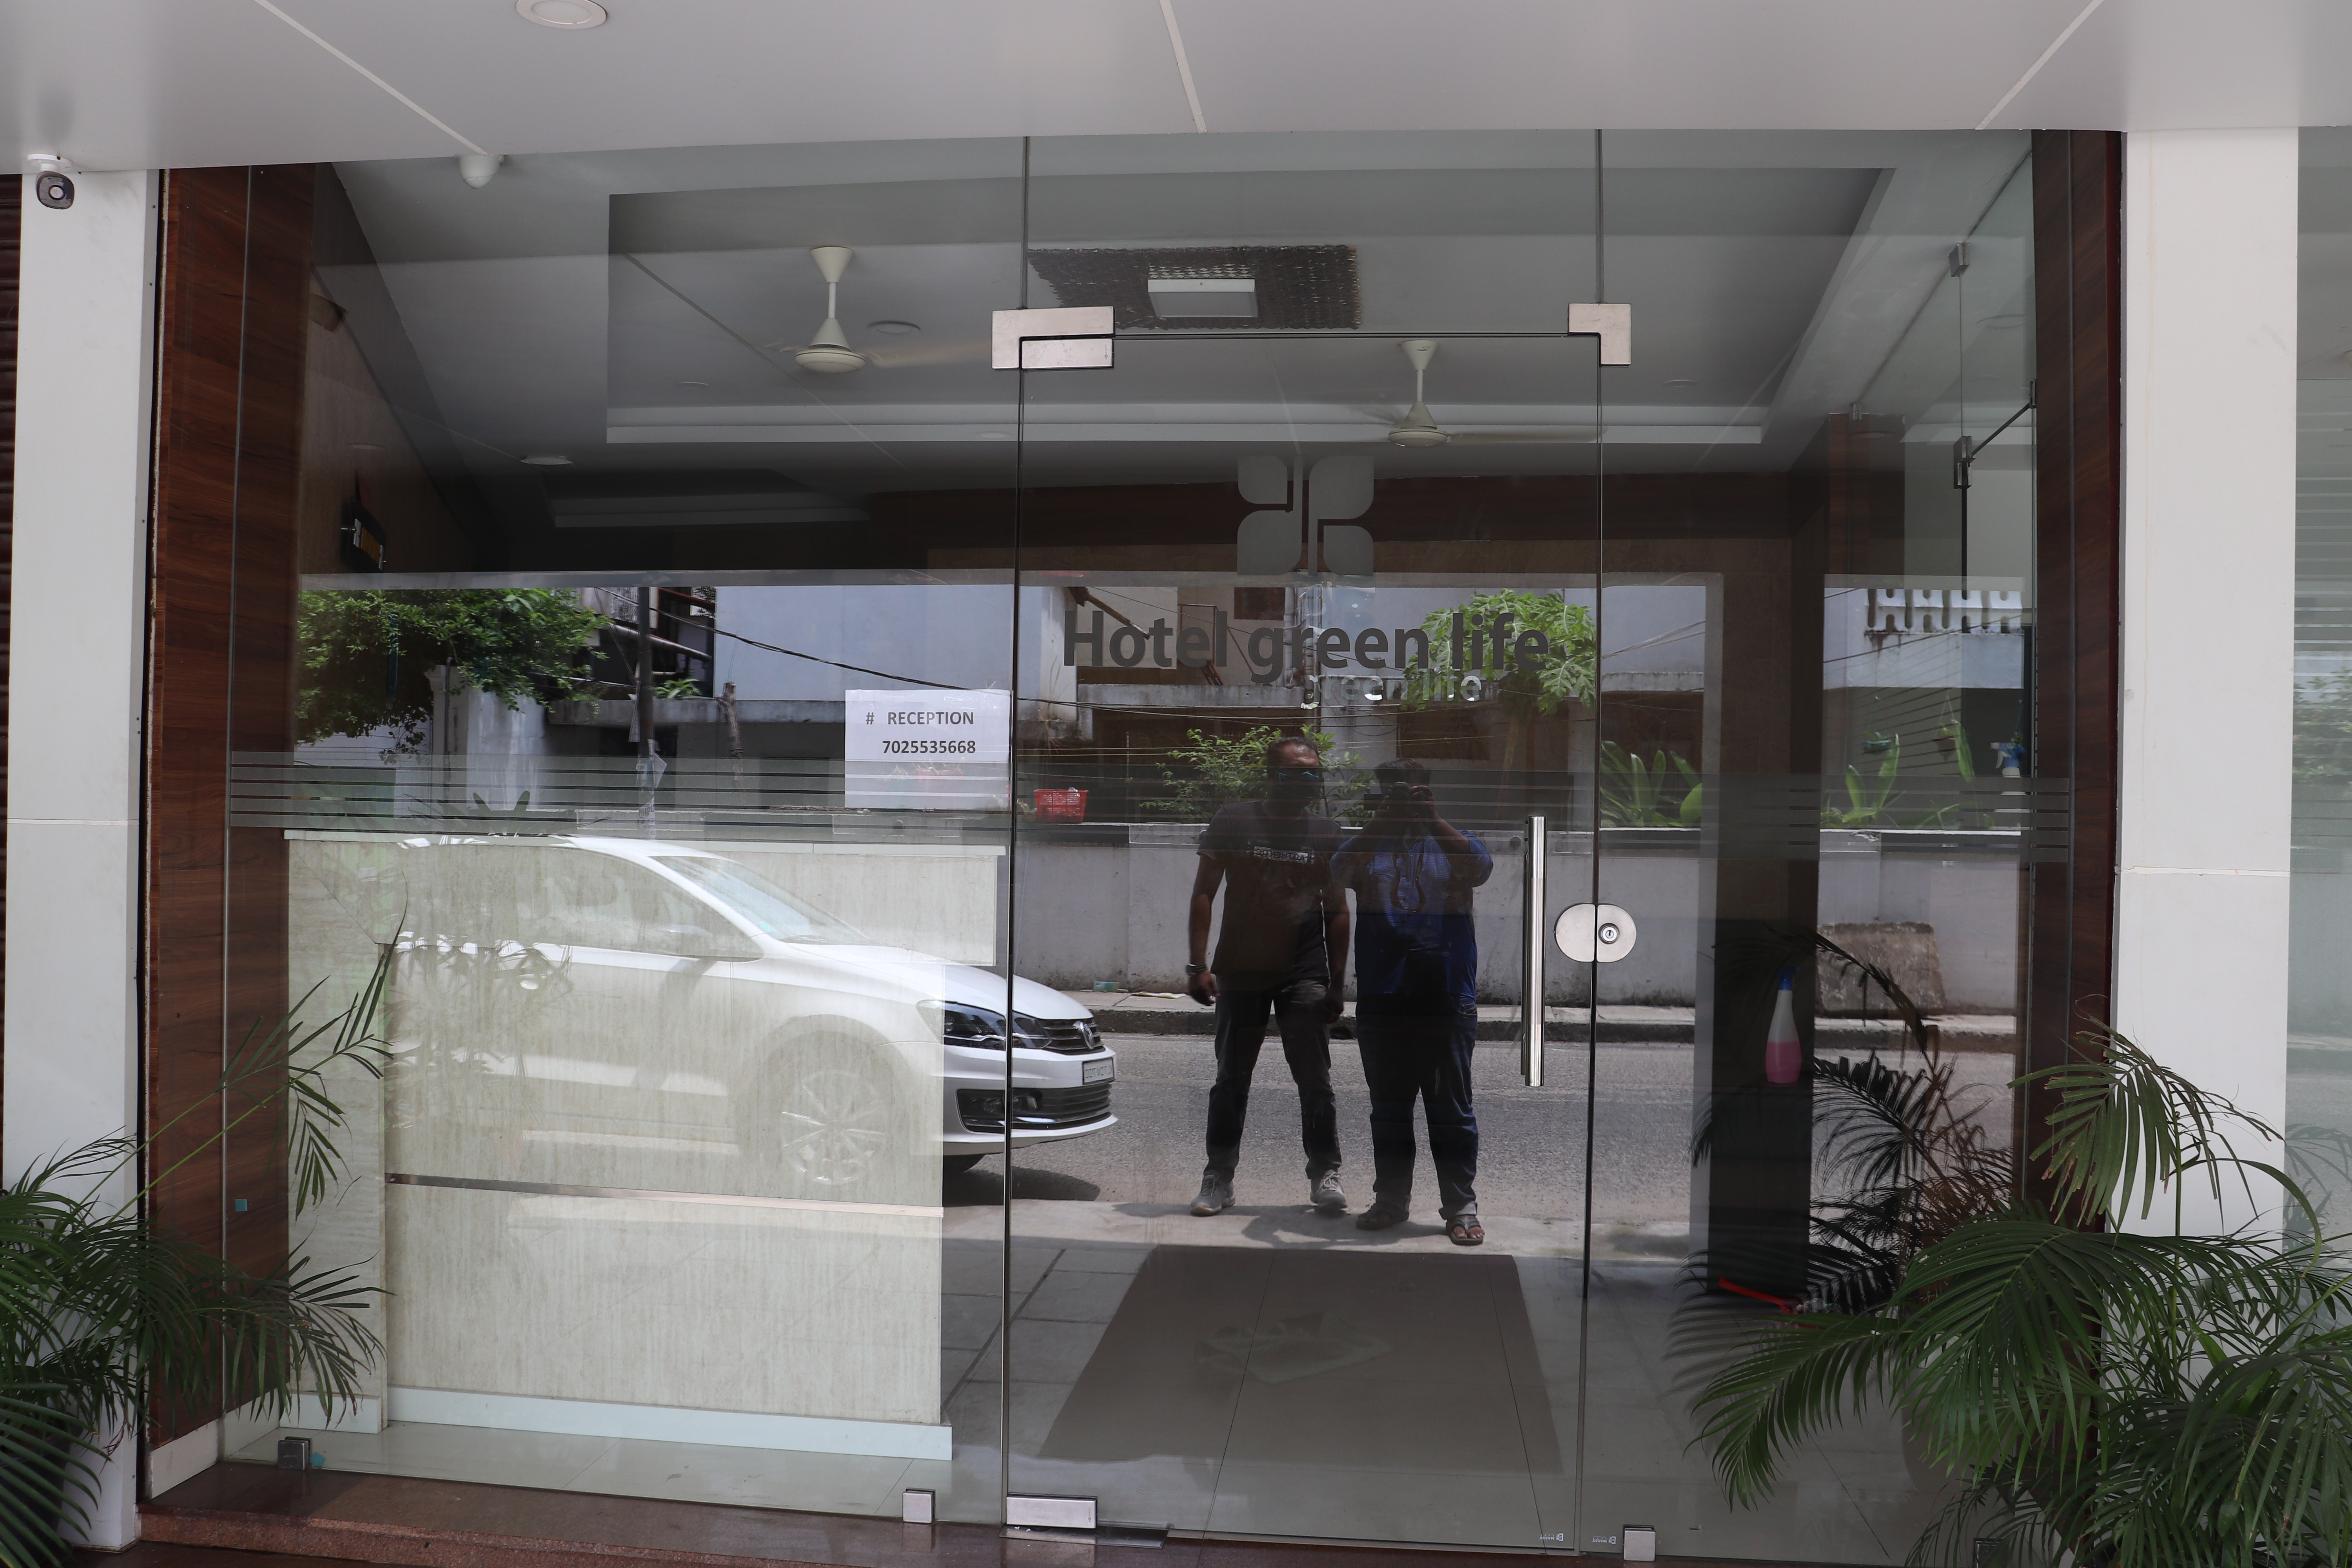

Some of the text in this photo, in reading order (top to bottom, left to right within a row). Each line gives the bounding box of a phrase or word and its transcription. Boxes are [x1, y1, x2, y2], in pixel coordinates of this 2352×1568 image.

[1064, 610, 1548, 683] Hotel green life
[1300, 674, 1408, 710] green
[1423, 666, 1482, 701] life
[866, 711, 974, 725] # RECEPTION
[882, 740, 976, 754] 7025535668
